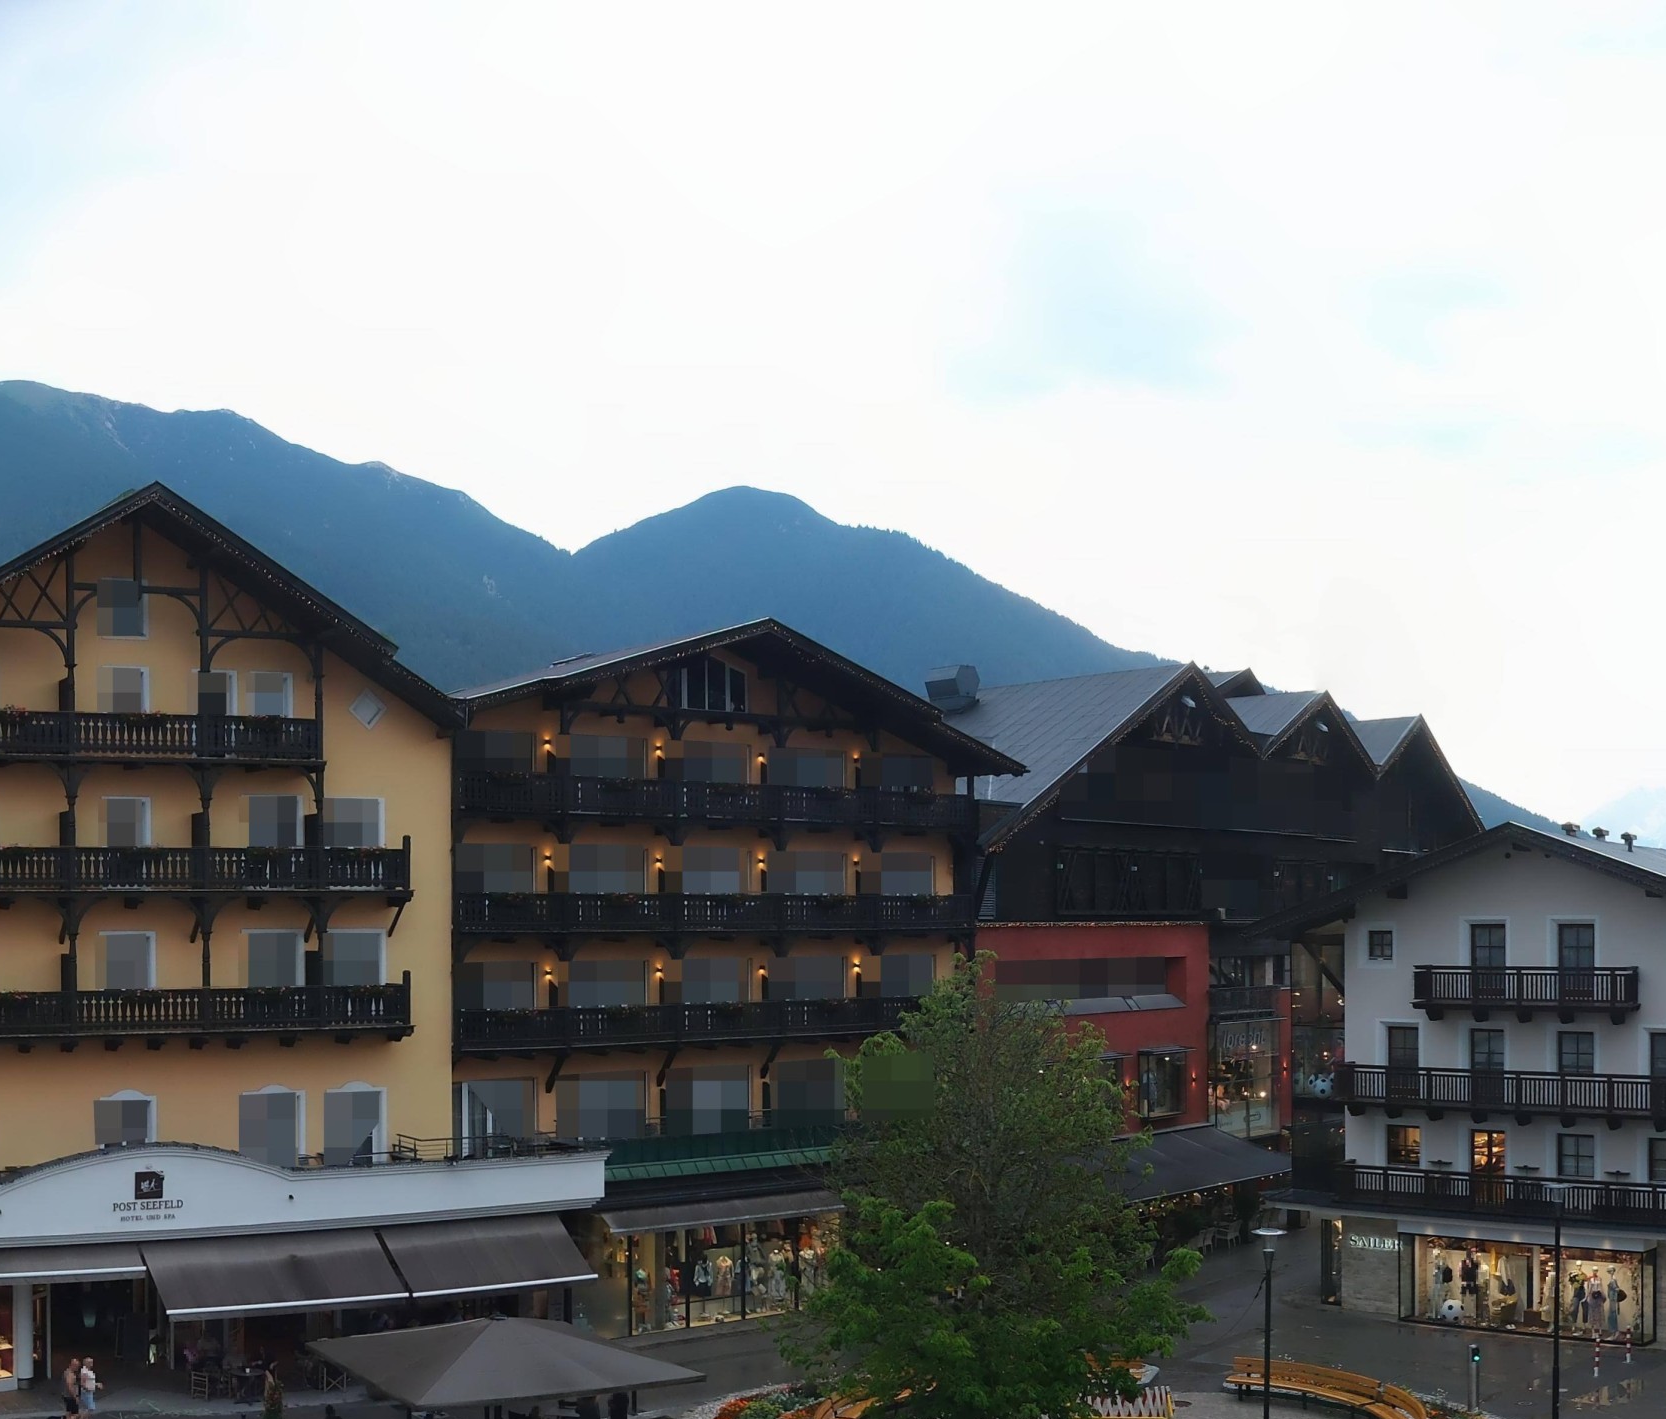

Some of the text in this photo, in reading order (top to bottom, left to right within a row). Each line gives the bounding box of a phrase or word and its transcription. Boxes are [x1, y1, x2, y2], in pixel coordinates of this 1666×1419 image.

[113, 1199, 184, 1212] POST SEEFELD
[1349, 1234, 1403, 1252] SAILER
